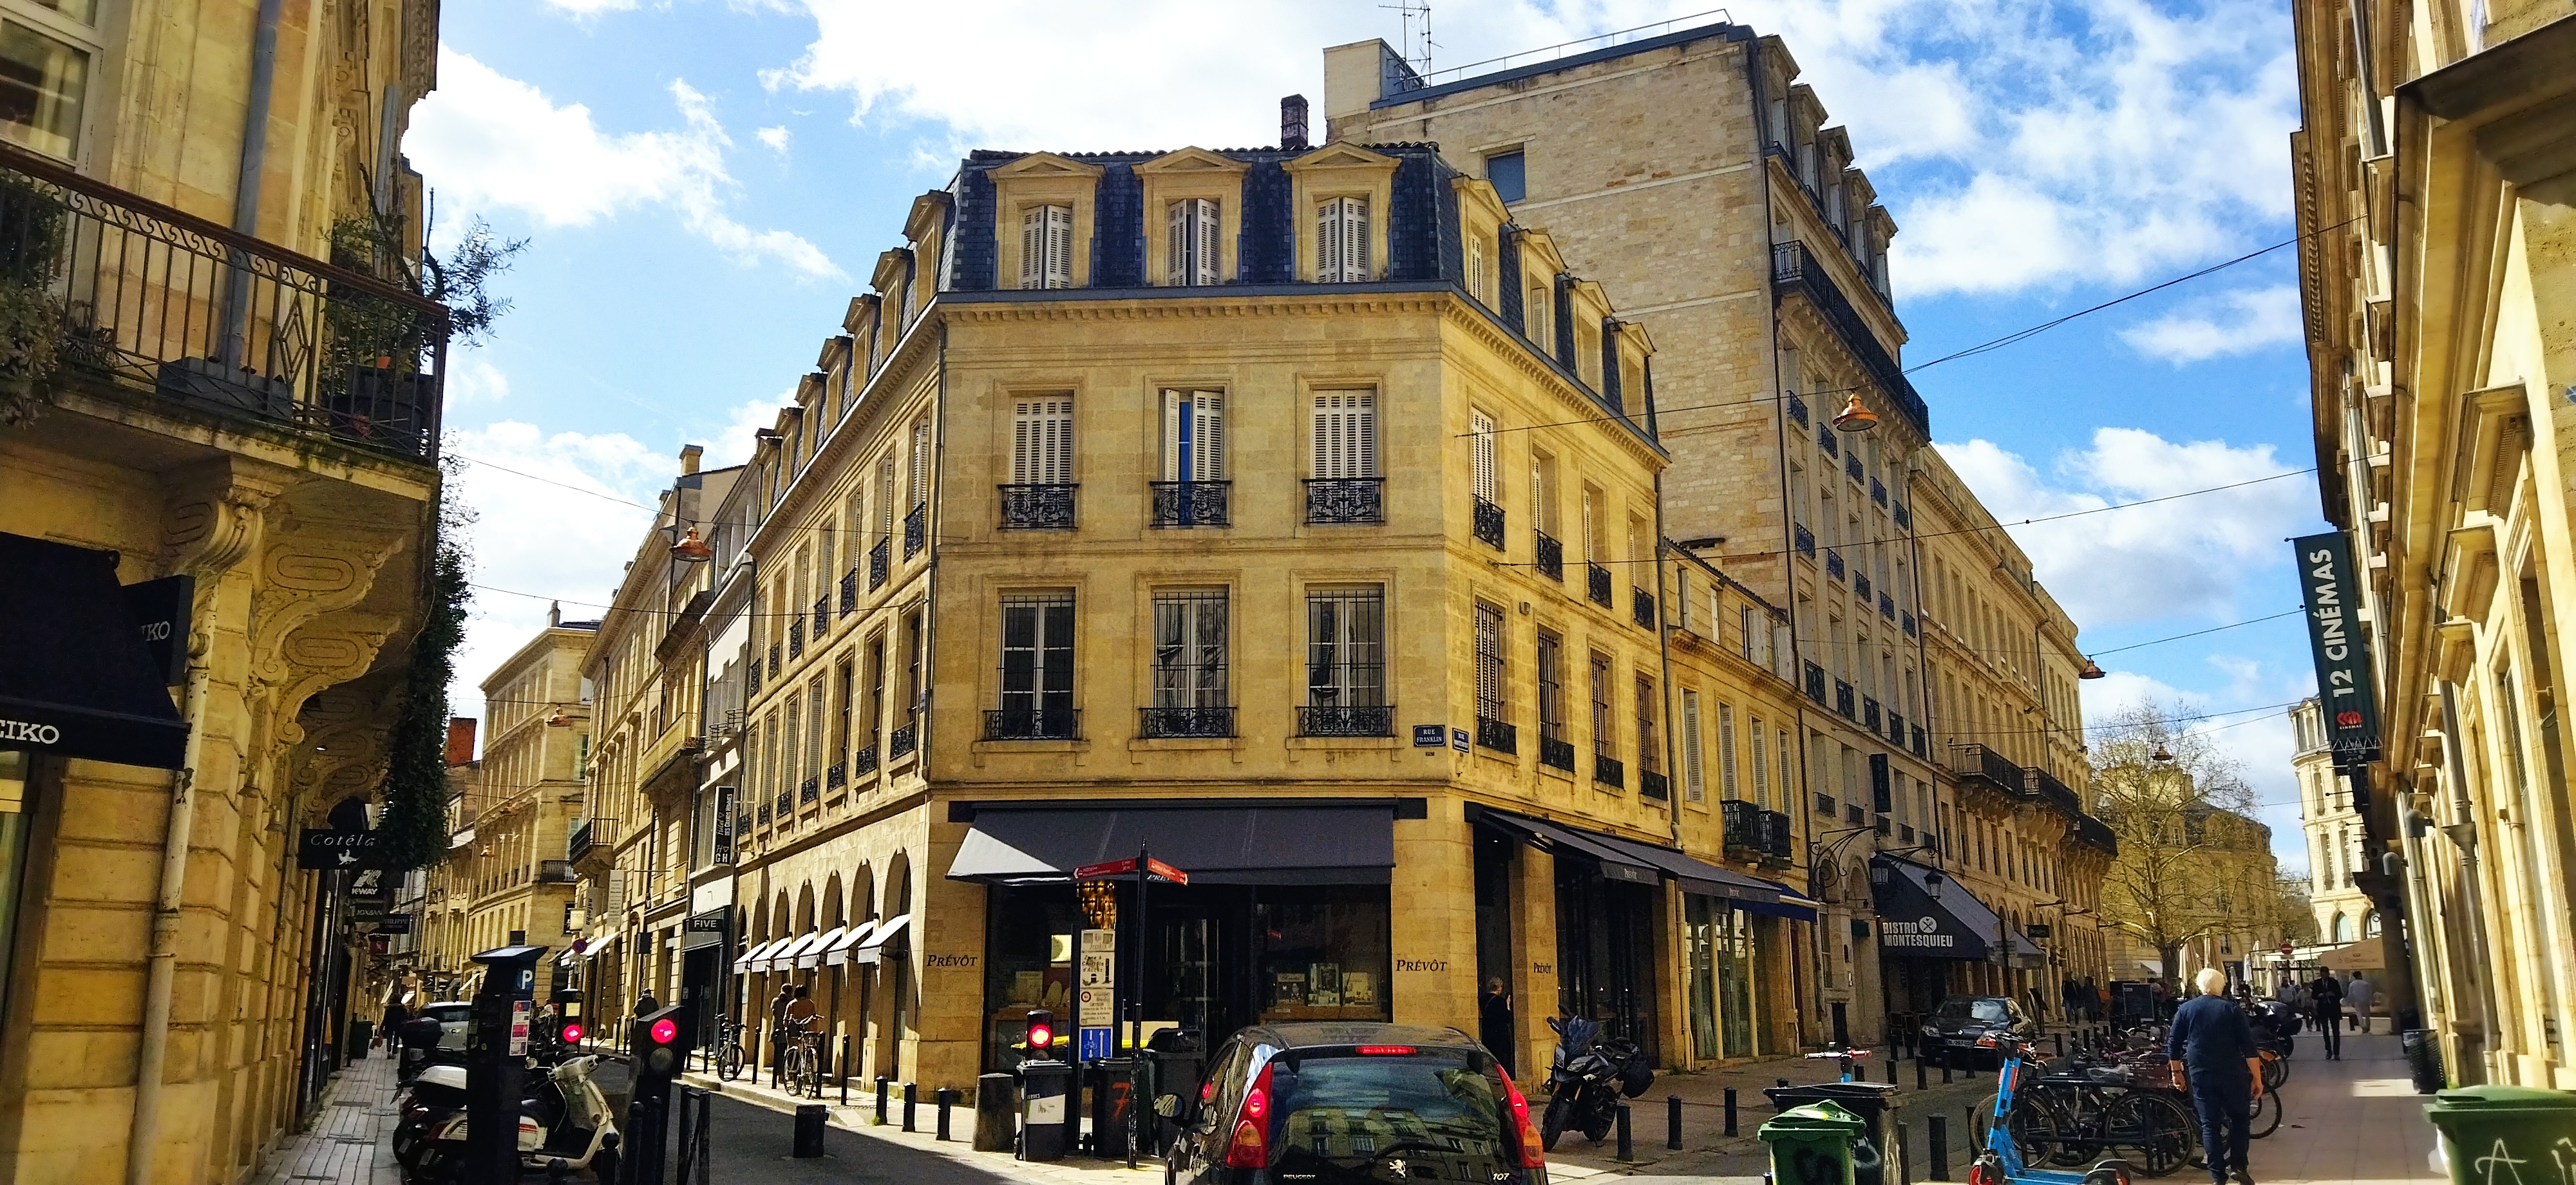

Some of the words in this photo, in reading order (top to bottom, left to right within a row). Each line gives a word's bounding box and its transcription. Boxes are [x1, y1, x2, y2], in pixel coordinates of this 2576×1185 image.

[2309, 549, 2349, 661] CINÉMAS
[2329, 668, 2355, 698] 12
[310, 834, 381, 846] Cotéla
[1882, 922, 1918, 934] BISTRO
[1884, 934, 1953, 947] MONTESQUIEU
[521, 970, 533, 990] P
[1112, 1083, 1131, 1120] 7
